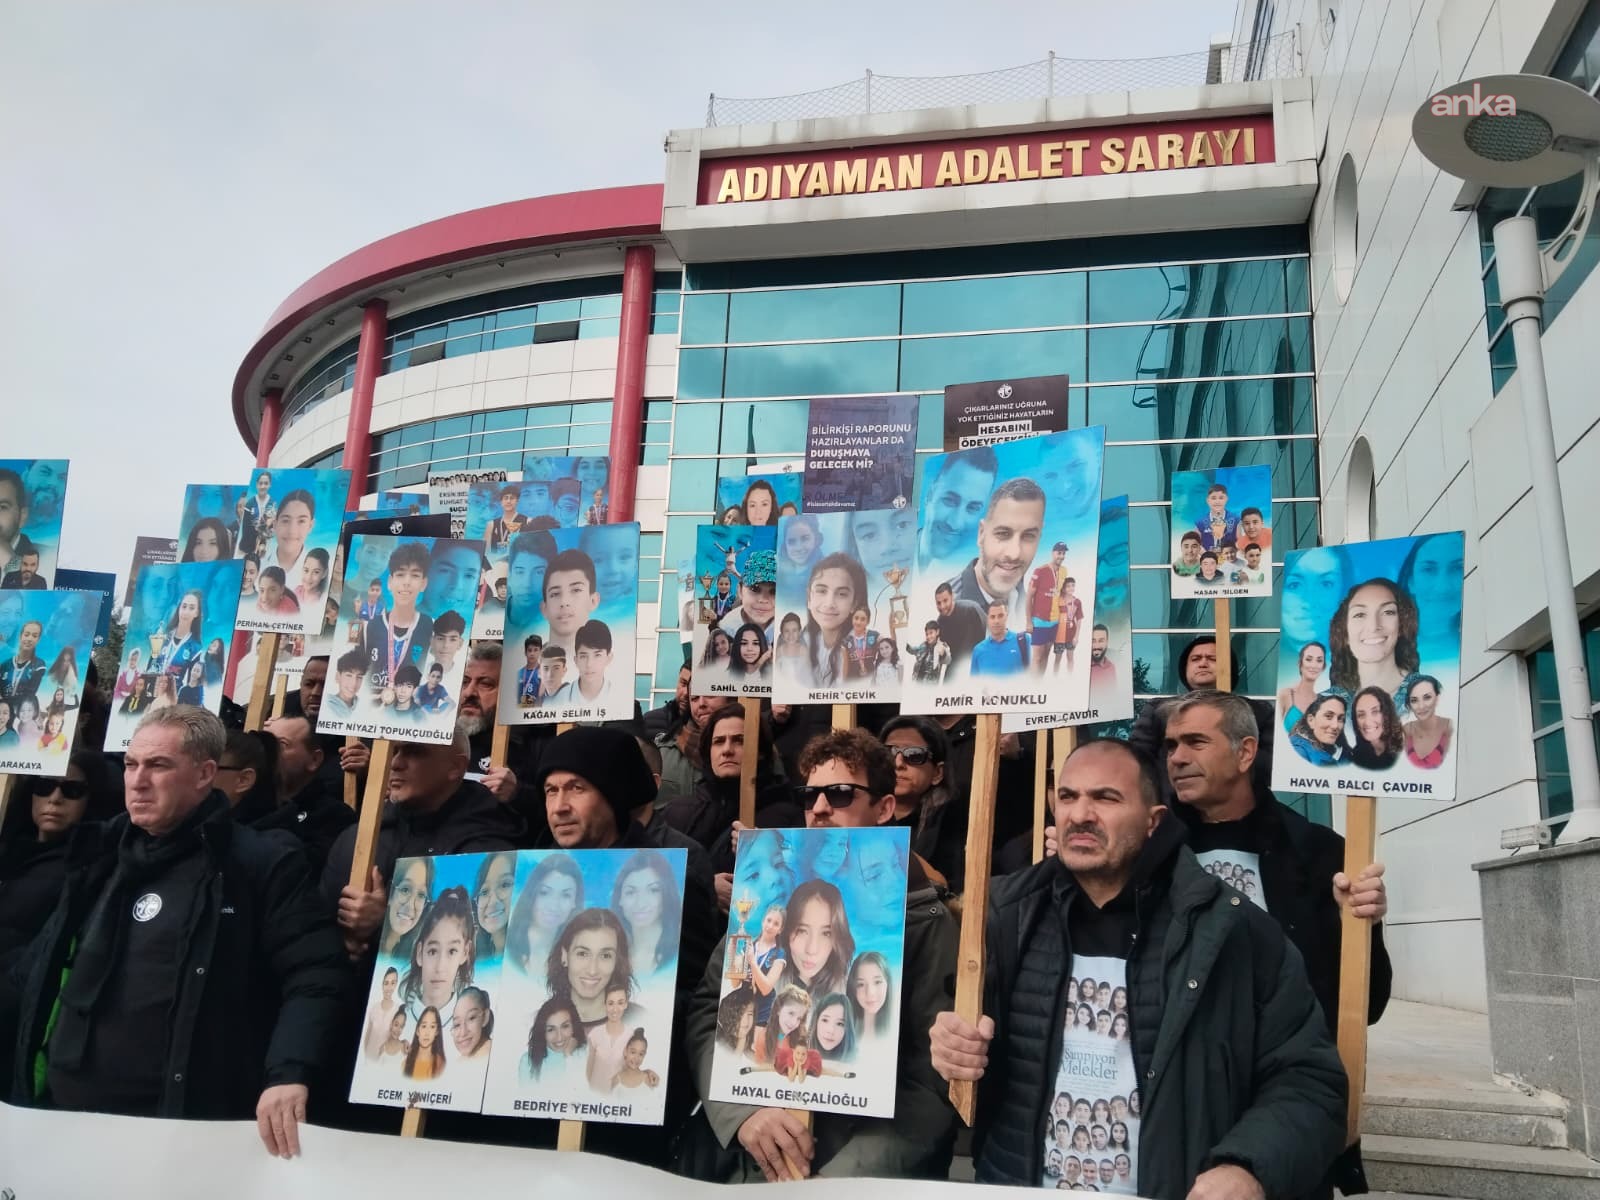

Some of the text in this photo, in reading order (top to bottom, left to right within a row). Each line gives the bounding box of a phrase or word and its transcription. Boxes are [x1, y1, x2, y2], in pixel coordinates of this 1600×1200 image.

[716, 126, 1257, 204] ADIYAMAN ADALET SARAYI
[964, 399, 1047, 415] ÇIKARLARINIZ UĞRUNA
[957, 414, 973, 424] YOK
[1009, 408, 1054, 419] HAYATLARIN
[811, 423, 912, 436] BİLİRKİŞİ RAPORUNU
[979, 422, 1031, 435] HESABINI
[811, 435, 905, 447] HAZIRLAYANLAR DA
[810, 448, 871, 460] DURUŞMAYA
[809, 457, 874, 470] GELECEK Mİ?
[271, 621, 305, 631] ÇETİNER
[710, 683, 773, 693] SAHİL ÖZBER
[808, 690, 876, 701] NEHİR ÇEVİK
[935, 693, 974, 708] PAMİR
[523, 707, 607, 720] KAĞAN SELİM İŞ
[1025, 709, 1100, 726] EVREN ÇAVDIR
[317, 720, 344, 729] MERT
[345, 722, 377, 734] NİYAZİ
[0, 760, 42, 770] ARAKAYA
[1289, 777, 1434, 794] HAVVA BALCI ÇAVDIR
[1061, 1060, 1119, 1080] Melekler
[377, 1089, 453, 1105] ECEM YNİÇERİ
[731, 1085, 771, 1099] HAYAL
[513, 1098, 633, 1117] BEDRİYE YENİÇERİ
